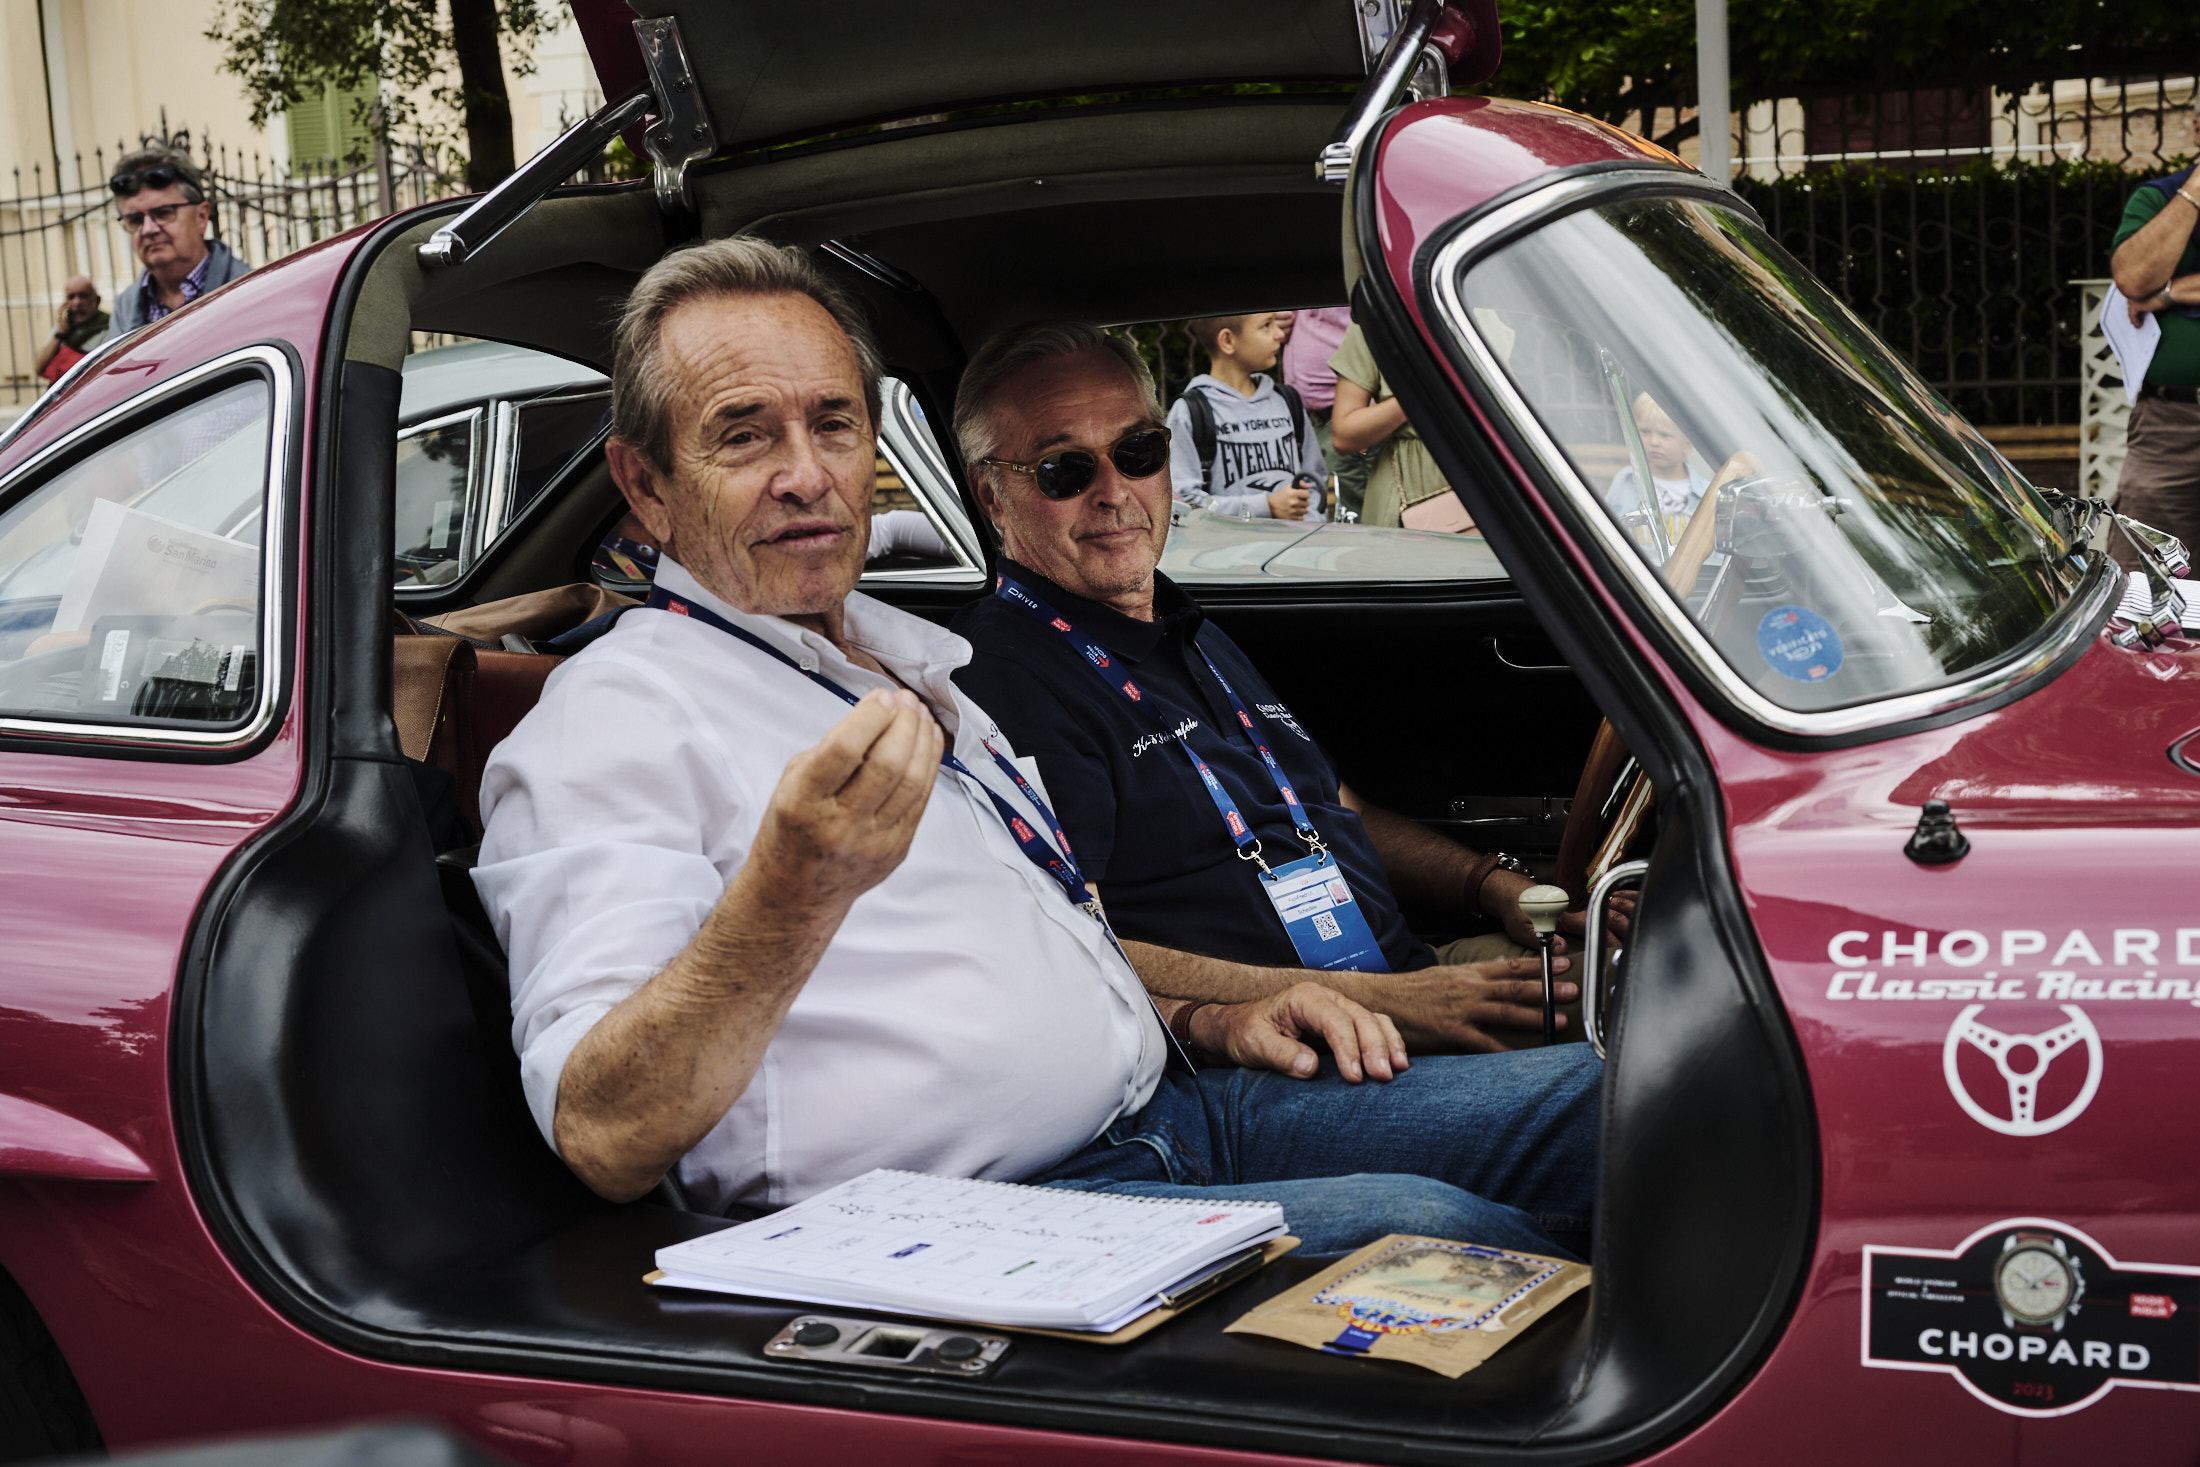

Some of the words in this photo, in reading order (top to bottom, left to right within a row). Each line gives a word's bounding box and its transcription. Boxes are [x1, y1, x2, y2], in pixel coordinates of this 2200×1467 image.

[1217, 422, 1240, 435] NEW
[1243, 419, 1271, 430] YORK
[1272, 417, 1291, 428] CITY
[1218, 432, 1296, 488] EVERLAST
[1007, 586, 1038, 609] DRIVER
[1014, 823, 1027, 840] 1000
[1826, 971, 2027, 1000] Classic
[1918, 1328, 2150, 1371] CHOPARD
[2012, 1382, 2055, 1400] 2023
